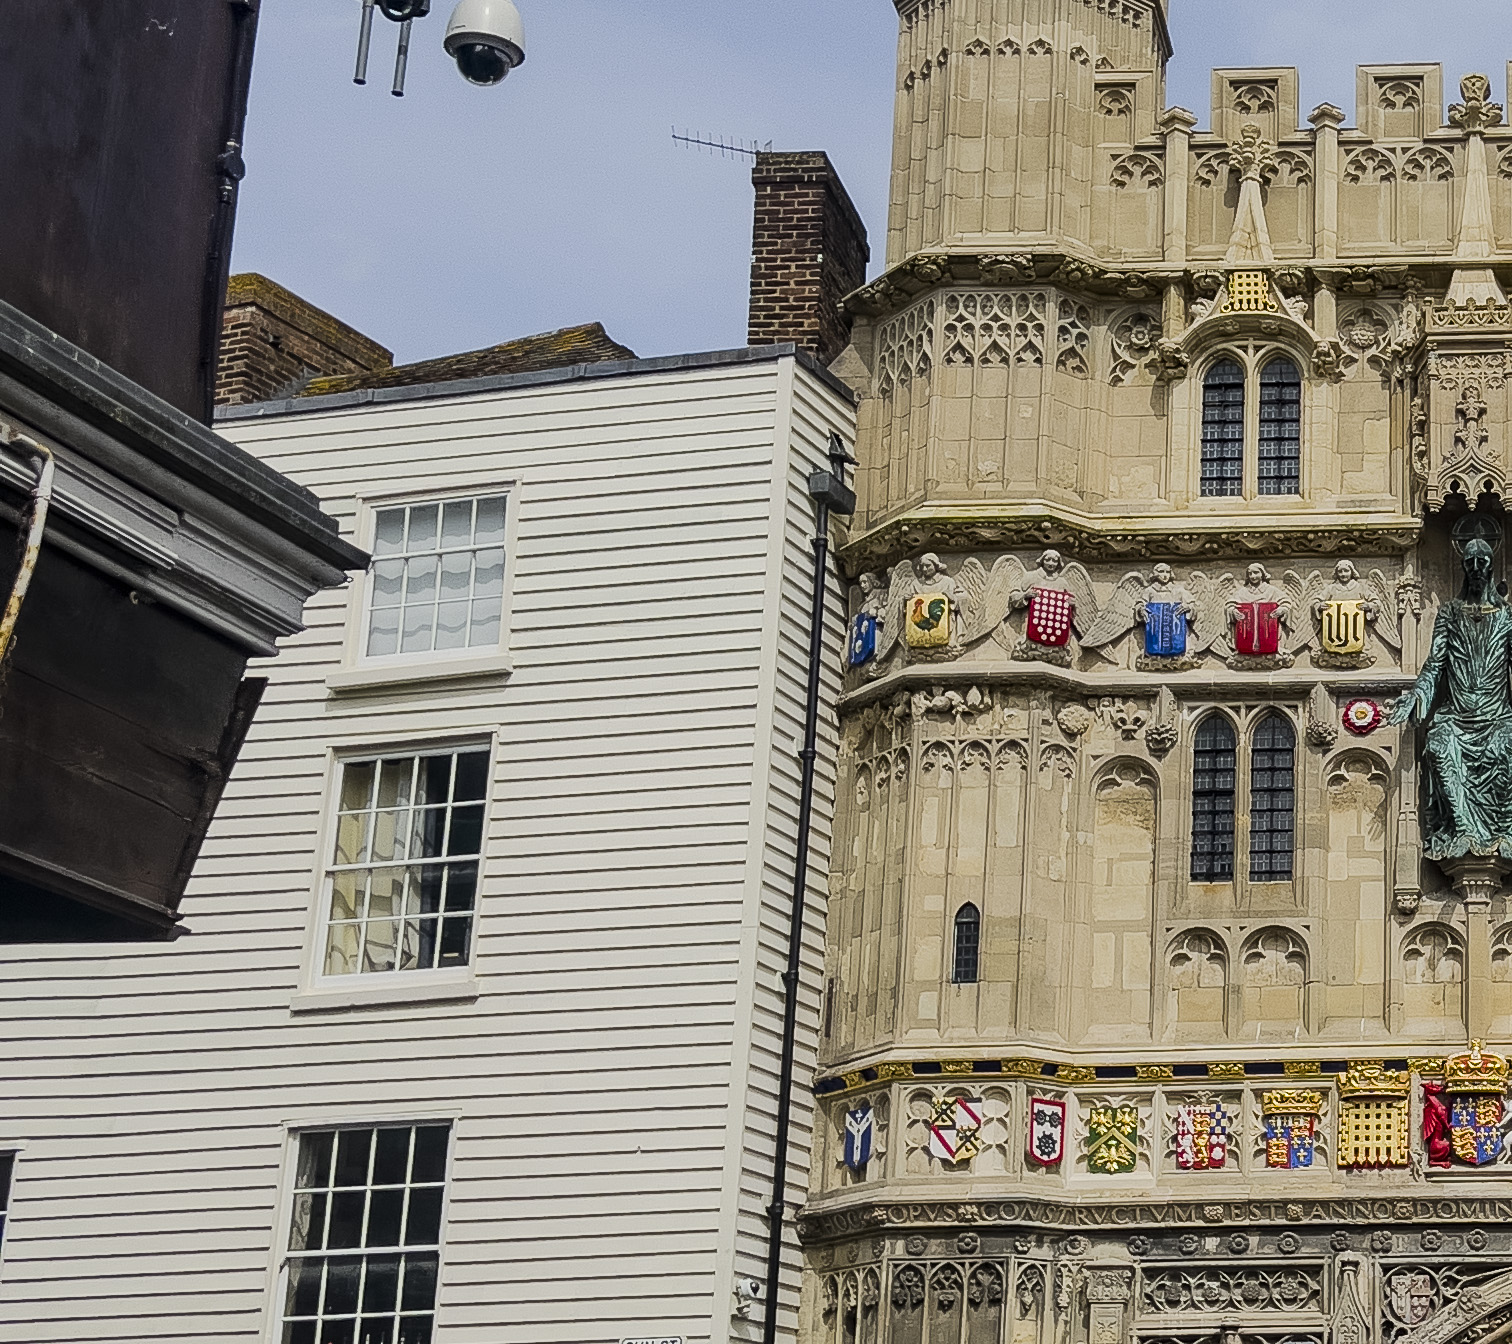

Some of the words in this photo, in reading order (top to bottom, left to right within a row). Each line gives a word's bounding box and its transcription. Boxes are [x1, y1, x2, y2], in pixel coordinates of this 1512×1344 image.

[887, 1204, 957, 1223] OPVS
[980, 1203, 1197, 1226] CONSTRVCTVM
[1230, 1205, 1277, 1221] EST
[1308, 1202, 1393, 1221] ANNO
